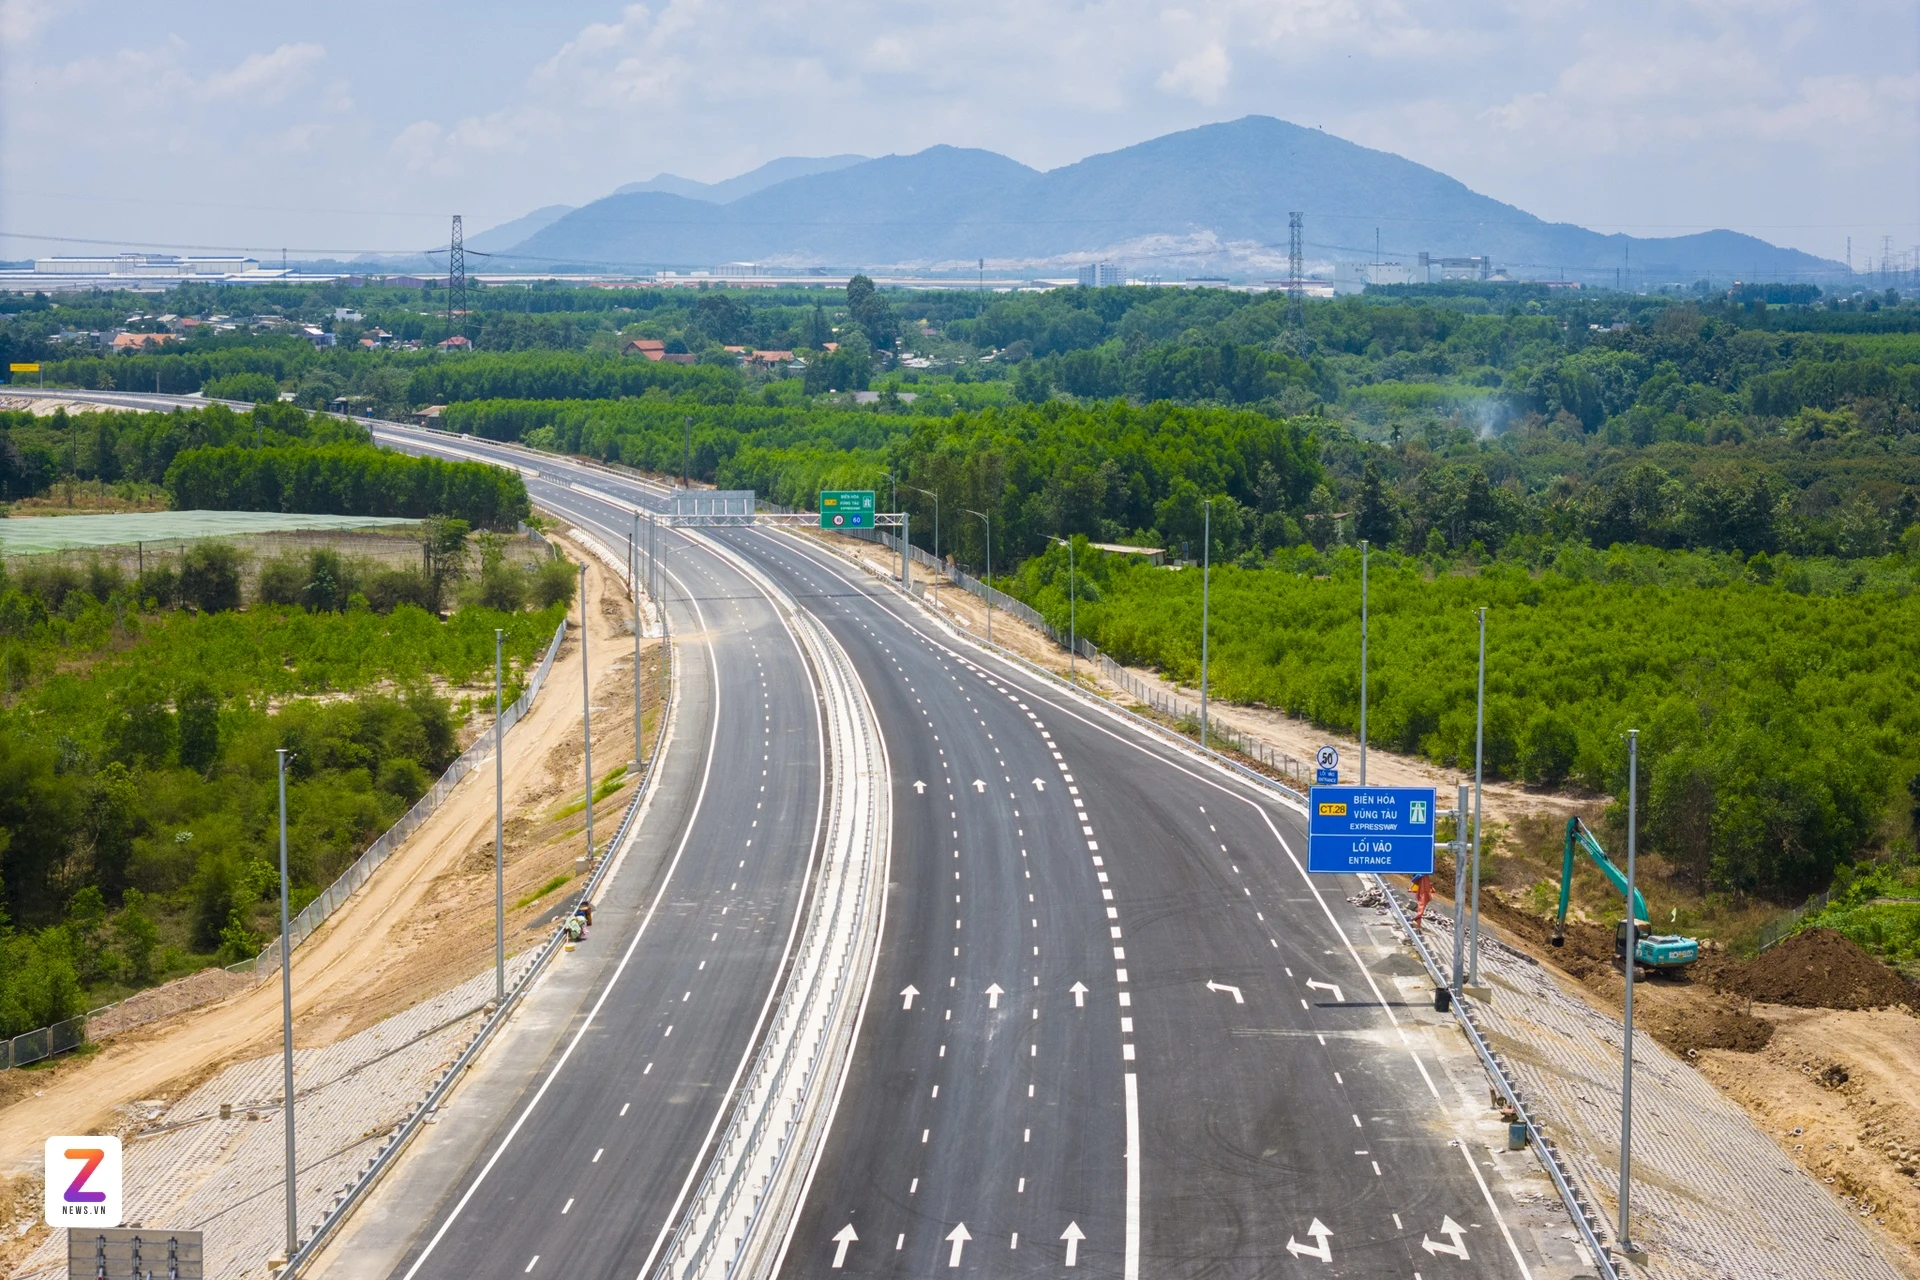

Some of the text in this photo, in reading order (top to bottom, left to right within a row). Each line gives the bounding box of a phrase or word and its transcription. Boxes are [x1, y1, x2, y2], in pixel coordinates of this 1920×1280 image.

[1322, 752, 1332, 764] 50
[1354, 793, 1395, 804] BIÊN HÒA
[1320, 806, 1346, 814] CT.28
[1354, 808, 1398, 820] VŨNG TÀU
[1350, 822, 1398, 830] EXPRESSWAY
[1352, 837, 1392, 852] LỐI VÀO
[1348, 856, 1392, 864] ENTRANCE
